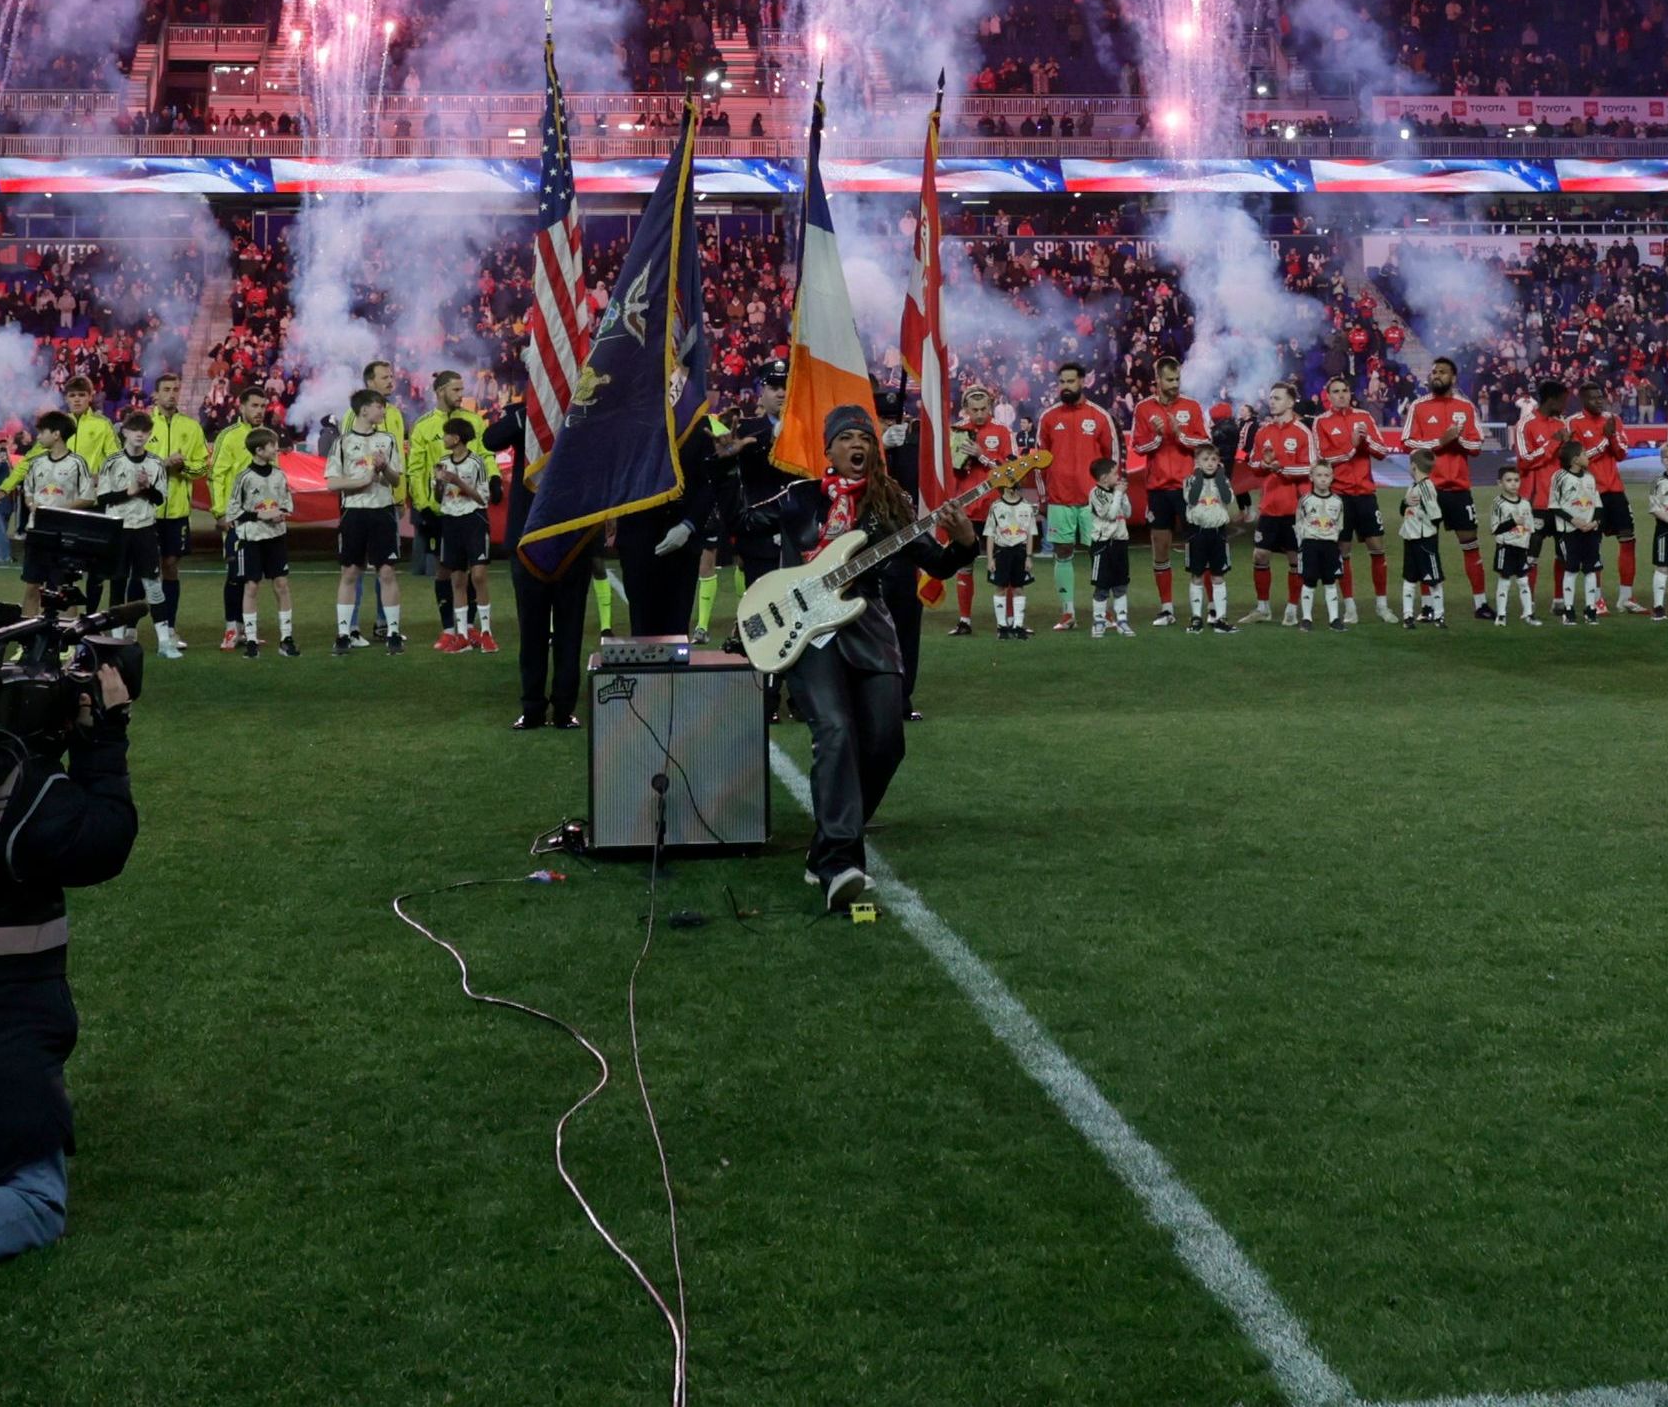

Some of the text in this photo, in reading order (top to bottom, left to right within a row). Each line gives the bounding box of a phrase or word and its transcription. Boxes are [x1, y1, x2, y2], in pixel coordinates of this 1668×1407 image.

[1403, 104, 1439, 113] TOYOTA
[1470, 104, 1506, 113] TOYOTA
[1536, 104, 1572, 113] TOYOTA
[1602, 104, 1637, 113] TOYOTA
